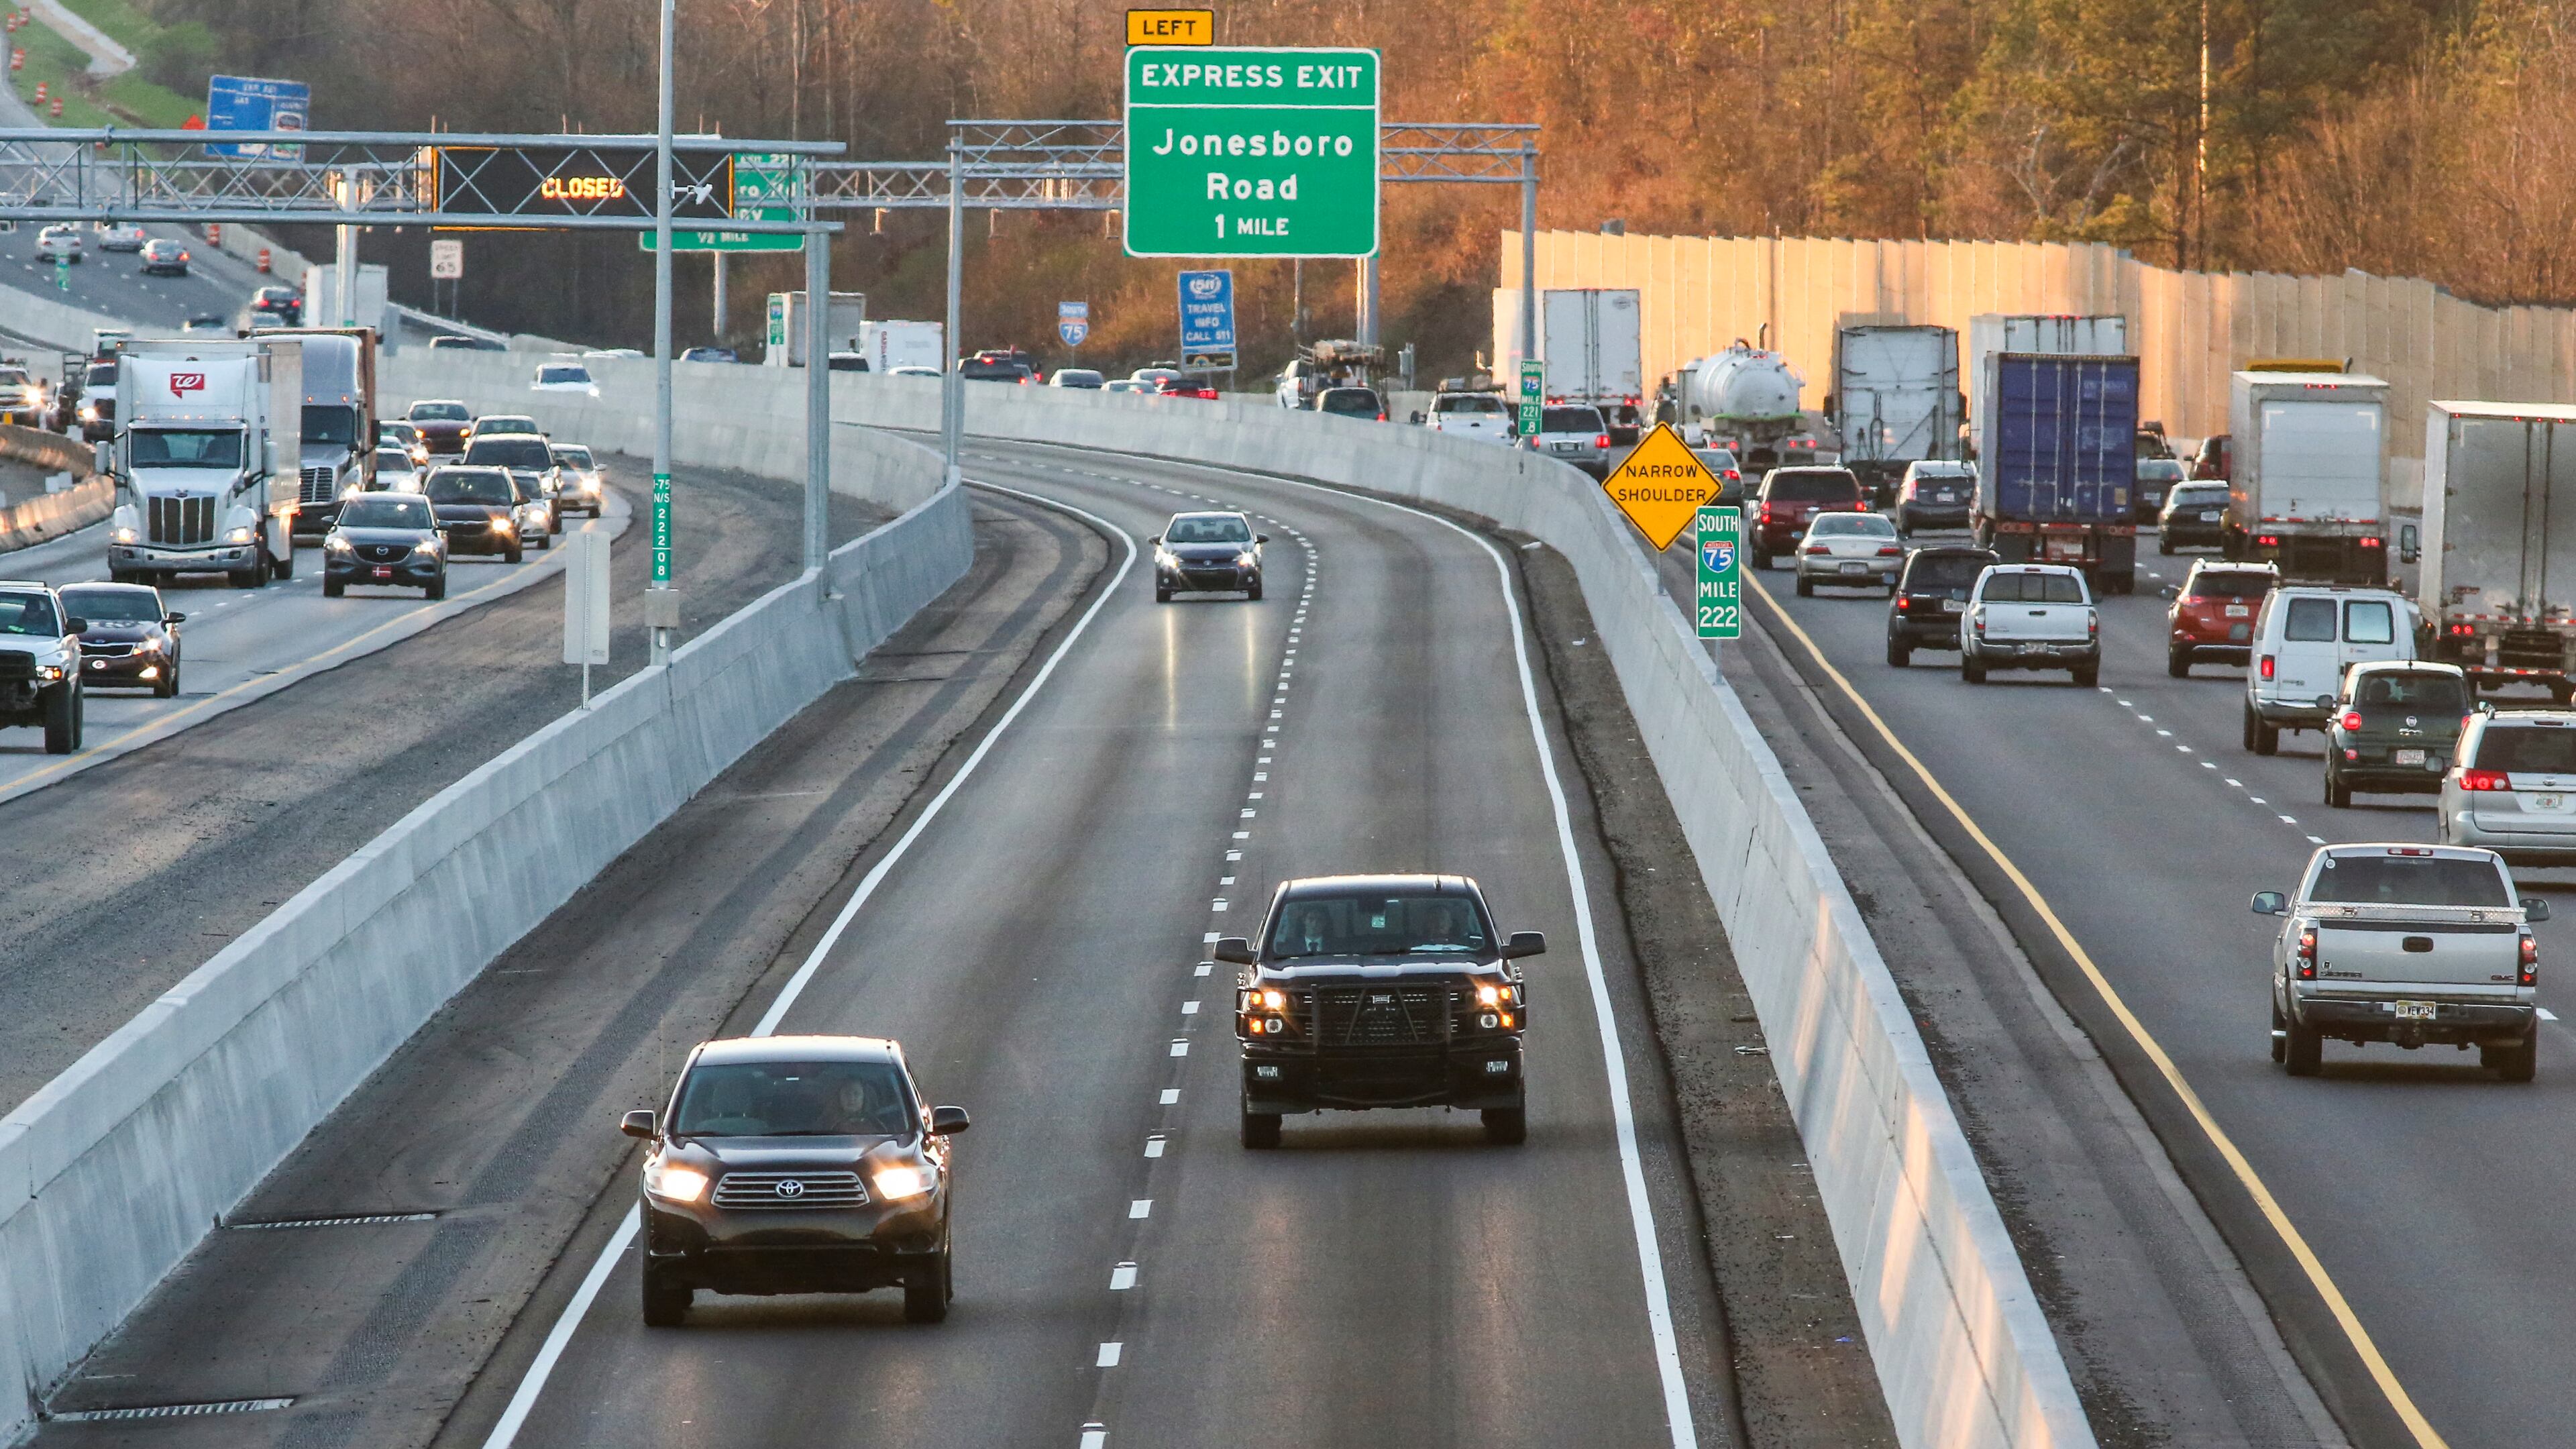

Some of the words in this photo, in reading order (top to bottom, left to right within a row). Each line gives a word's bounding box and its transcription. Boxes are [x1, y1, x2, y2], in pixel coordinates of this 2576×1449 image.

[1143, 19, 1197, 36] LEFT
[1142, 63, 1284, 89] EXPRESS
[1297, 65, 1362, 89] EXIT
[1152, 128, 1354, 156] Jonesboro
[541, 176, 625, 199] CLOSED
[1207, 172, 1298, 201] Road
[1215, 213, 1225, 239] 1
[1237, 217, 1289, 235] MILE
[1187, 304, 1226, 314] TRAVEL
[1195, 317, 1219, 327] INFO
[1063, 325, 1083, 340] 75
[1186, 332, 1212, 341] CALL
[1216, 331, 1230, 339] 511
[1524, 379, 1539, 389] 75
[1521, 395, 1541, 405] MILE
[1523, 407, 1539, 417] 221
[1626, 465, 1697, 478] NARROW
[653, 493, 669, 503] N/S
[1619, 488, 1706, 502] SHOULDER
[1699, 514, 1739, 532] SOUTH
[1705, 549, 1731, 567] 75
[1700, 582, 1737, 598] MILE
[1699, 606, 1737, 627] 222
